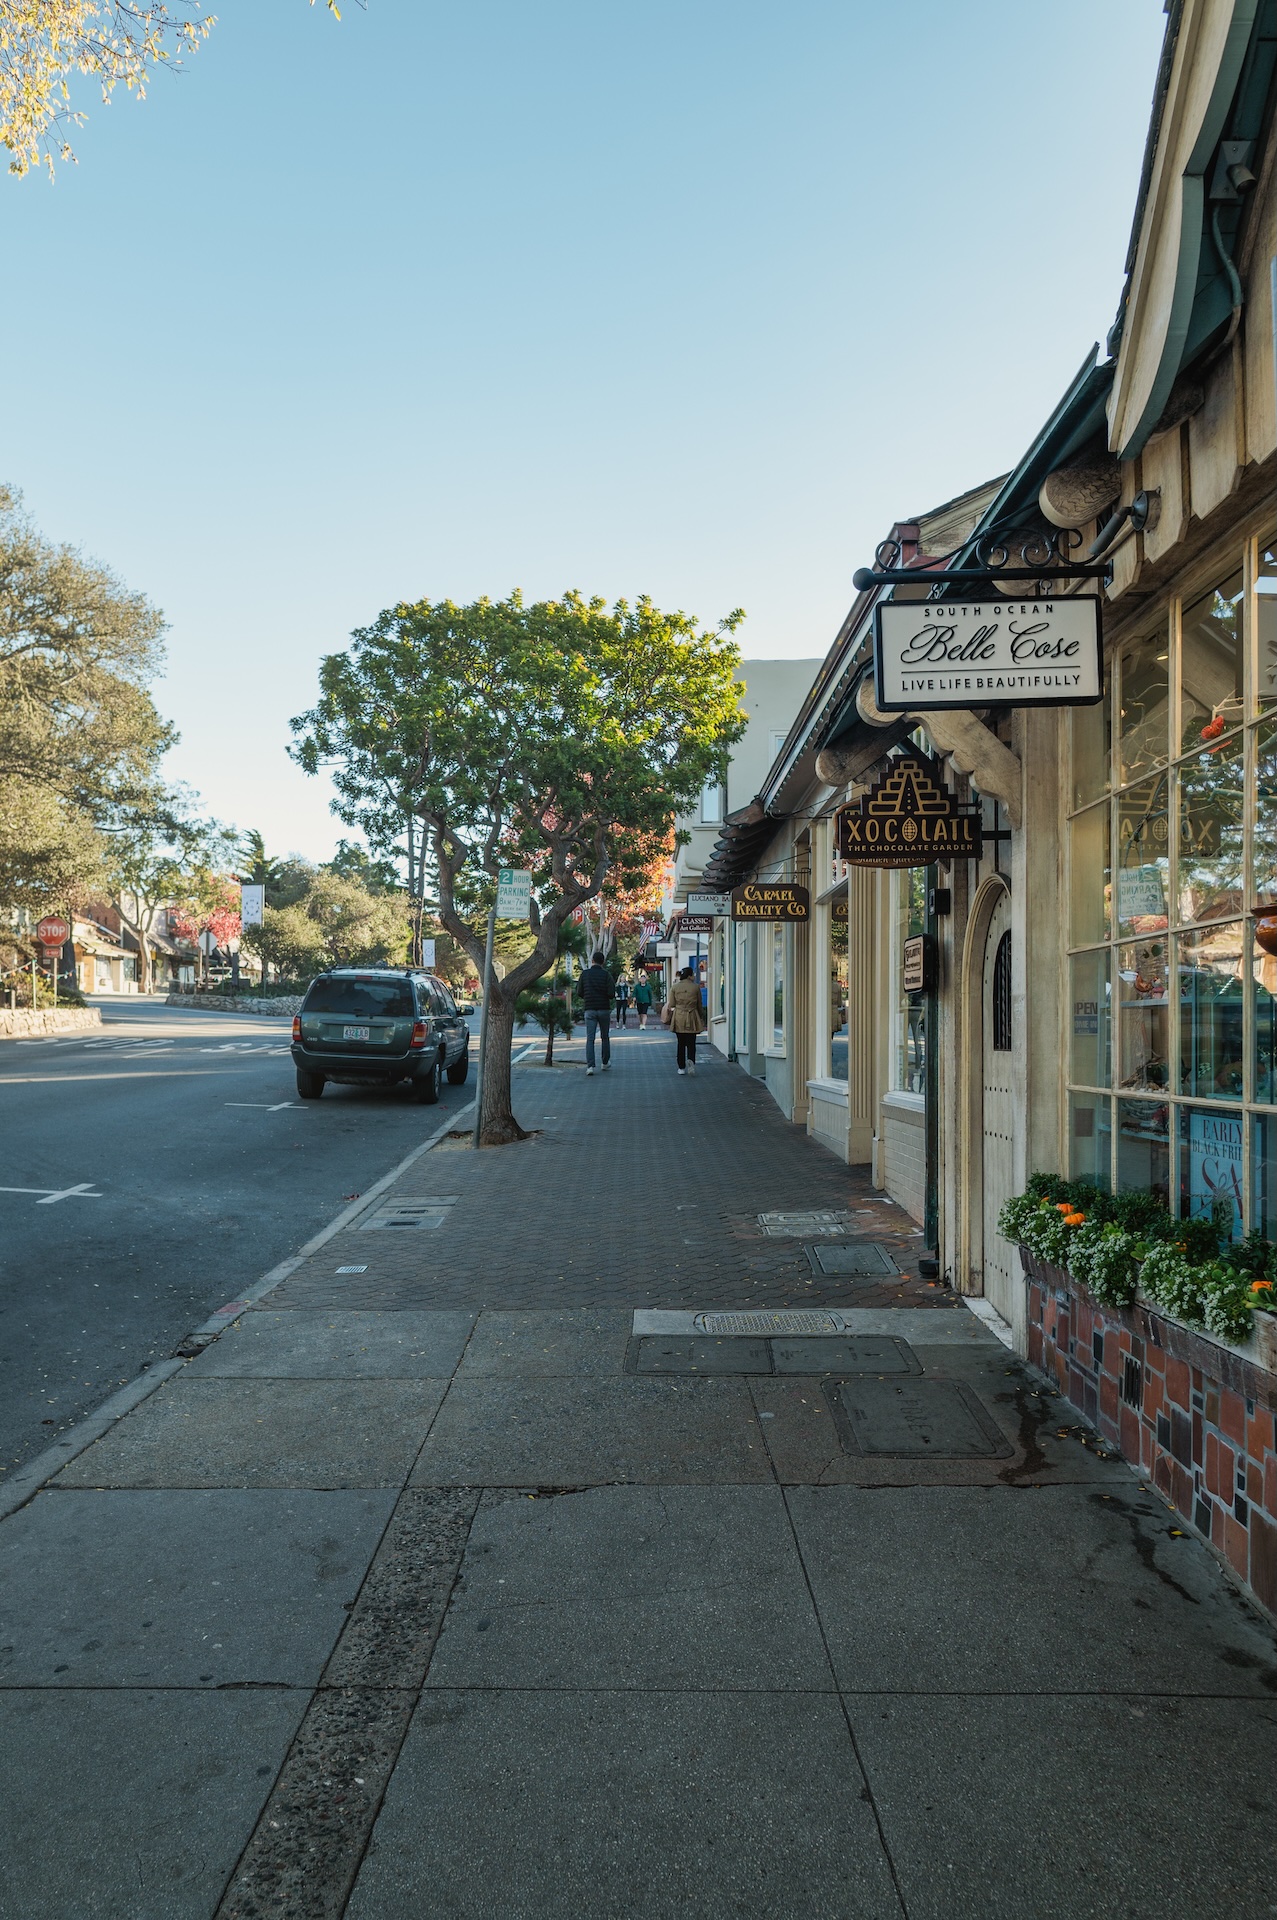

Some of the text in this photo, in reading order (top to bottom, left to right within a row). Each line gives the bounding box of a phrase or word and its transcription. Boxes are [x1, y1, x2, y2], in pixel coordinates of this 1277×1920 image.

[924, 604, 1054, 617] SOUTH OCEAN
[900, 620, 1080, 664] Belle Cose
[902, 674, 1080, 691] LIVE LIFE BEAUTIFULLY
[846, 817, 973, 842] XOCOLATL
[869, 844, 929, 852] CHOCOLATE
[502, 871, 530, 884] 2 HOUR
[500, 886, 529, 897] PARKING
[40, 926, 65, 937] STOP
[1202, 1119, 1243, 1145] EARLY
[1192, 1138, 1220, 1158] BLACK
